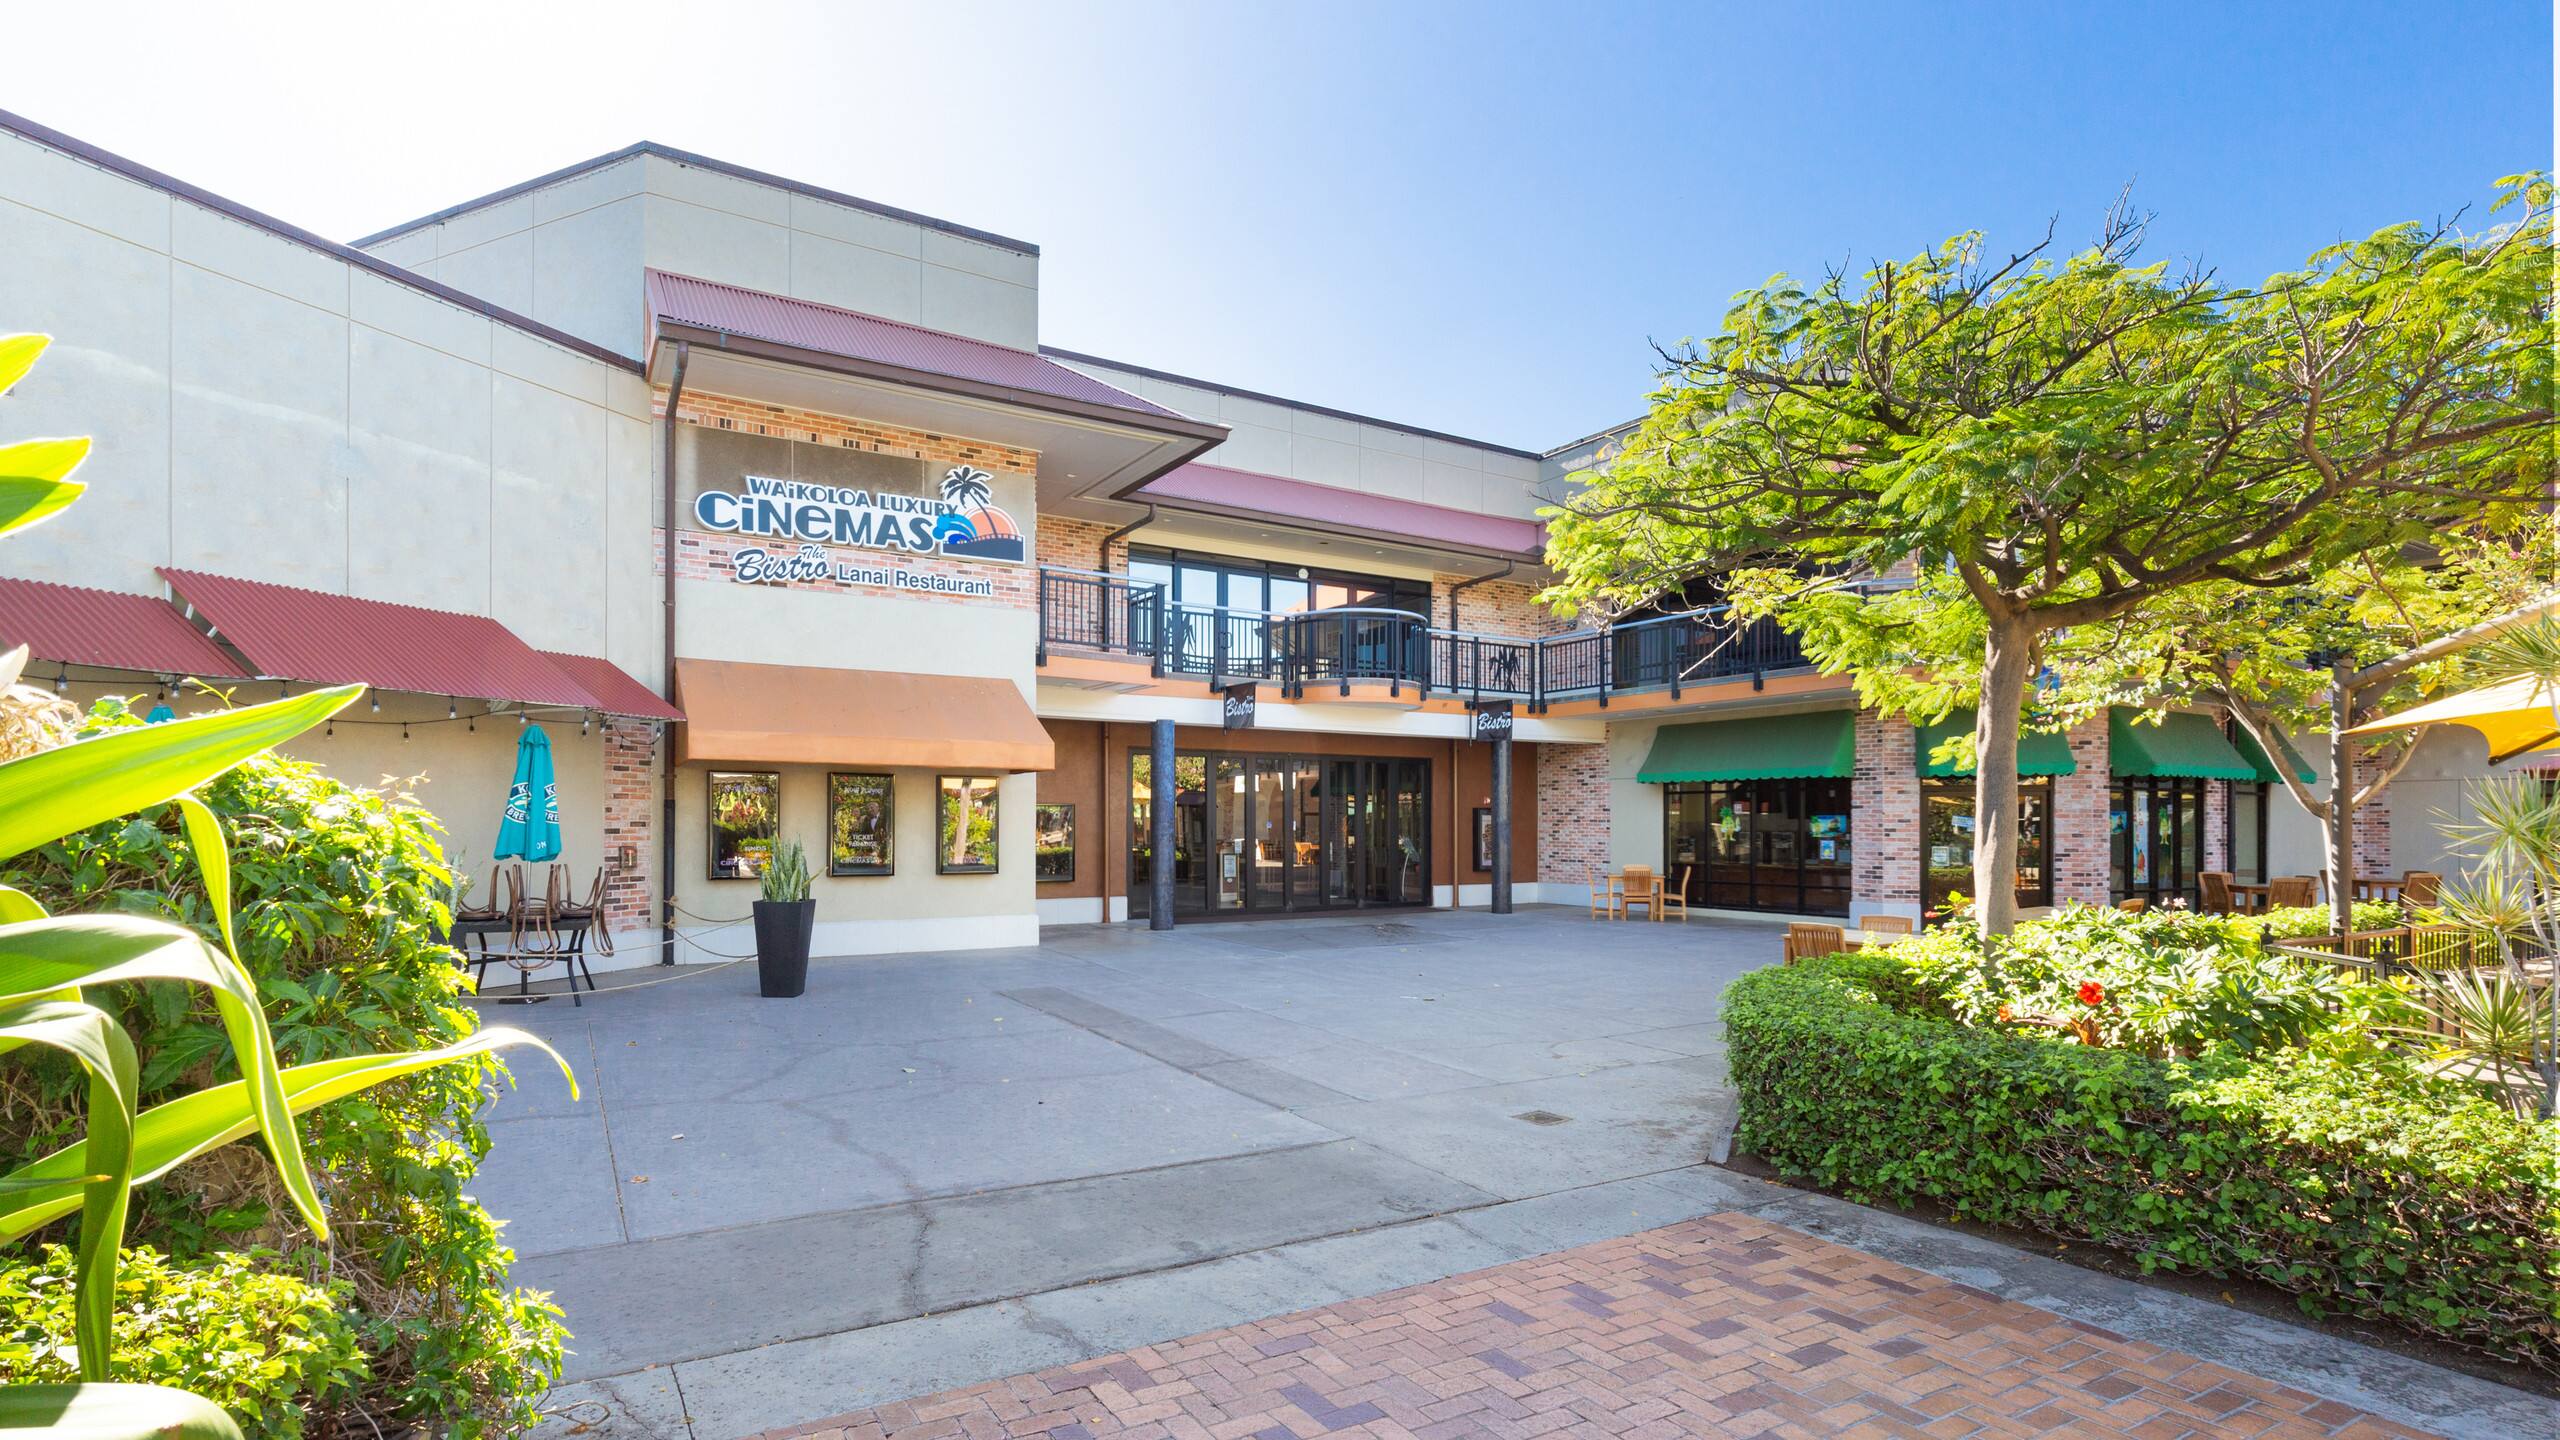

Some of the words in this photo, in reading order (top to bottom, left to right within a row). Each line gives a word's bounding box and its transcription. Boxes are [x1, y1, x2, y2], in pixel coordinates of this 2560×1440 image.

[879, 495, 958, 519] LUXURY
[801, 545, 826, 559] The
[734, 548, 830, 581] Bistro
[838, 564, 889, 585] Lanai
[895, 570, 992, 595] Restaurant
[1226, 696, 1254, 717] Bistro
[1478, 712, 1512, 730] Bistro
